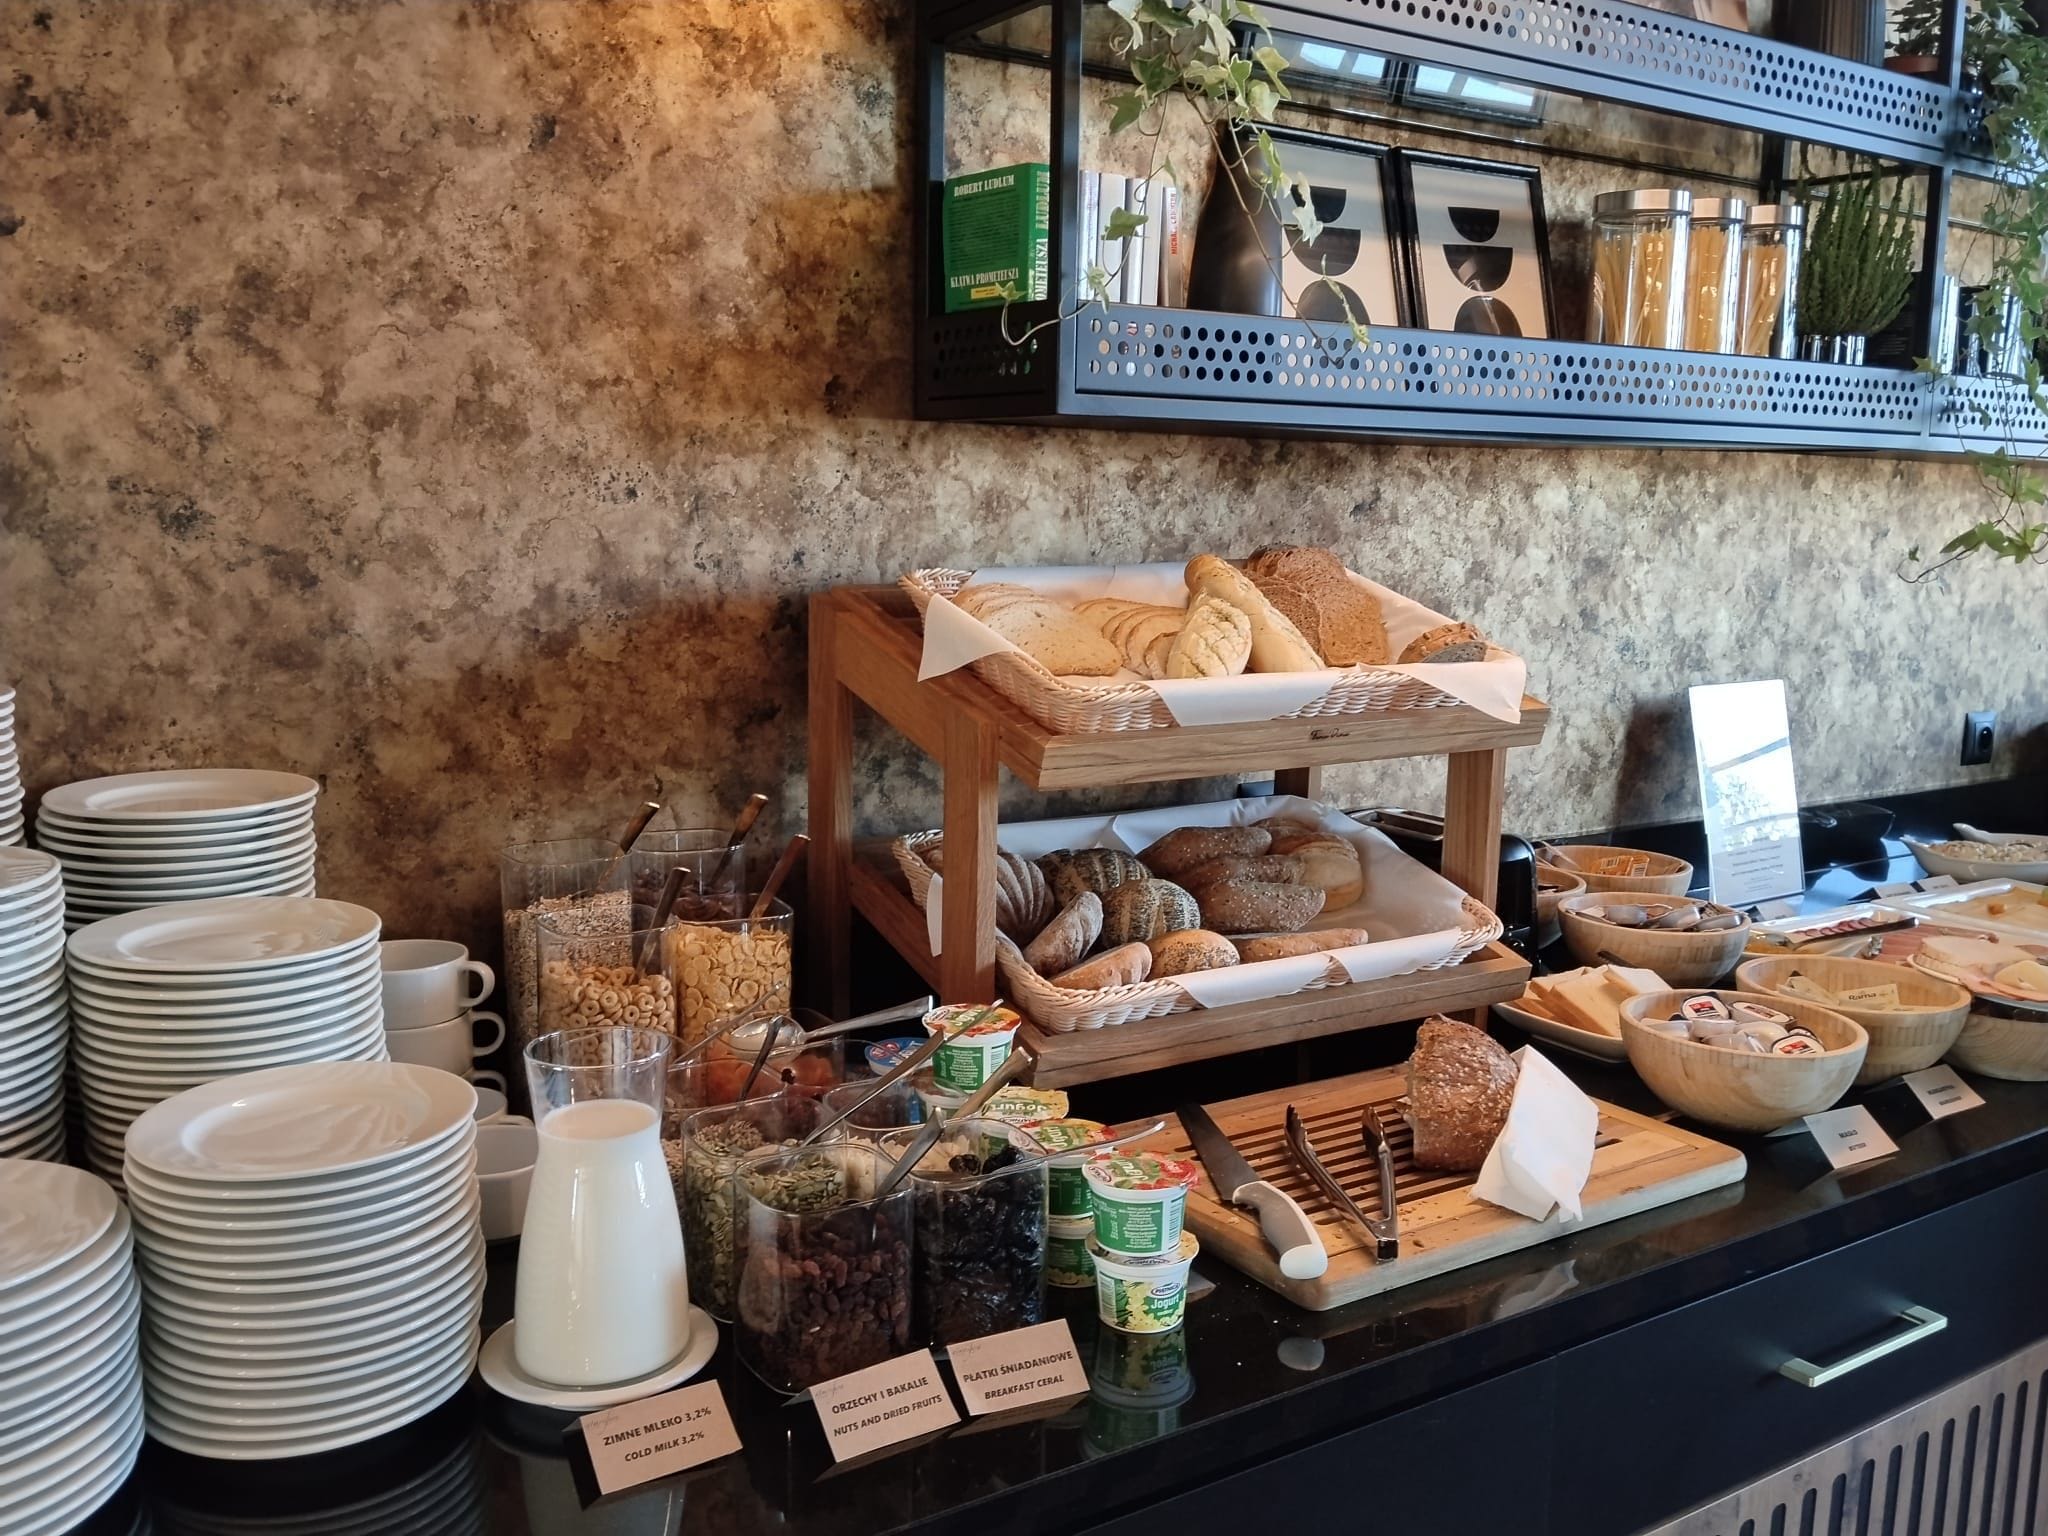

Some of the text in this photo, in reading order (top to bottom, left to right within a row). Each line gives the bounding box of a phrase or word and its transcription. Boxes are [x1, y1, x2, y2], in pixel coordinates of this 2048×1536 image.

[954, 174, 1015, 197] ROBERT LUDLUM
[1035, 170, 1050, 300] OMETEUSZA LUDLUM
[976, 267, 1019, 285] PROMETEUSZA
[1848, 992, 1877, 1001] Rama
[1151, 1295, 1180, 1309] Jogurt
[963, 1368, 999, 1383] PŁATKI
[1000, 1350, 1073, 1376] ŚNIADANIOWE
[832, 1392, 878, 1414] ORZECHY
[880, 1390, 885, 1399] I
[886, 1376, 929, 1397] BAKALIE
[985, 1374, 1065, 1400] BREAKFAST CERAL
[603, 1406, 712, 1446] ZIMNE MLEKO 3,2%
[833, 1394, 943, 1437] NUTS AND DRIED FRUITS
[624, 1447, 652, 1462] COLD
[681, 1431, 705, 1445] 3,2%
